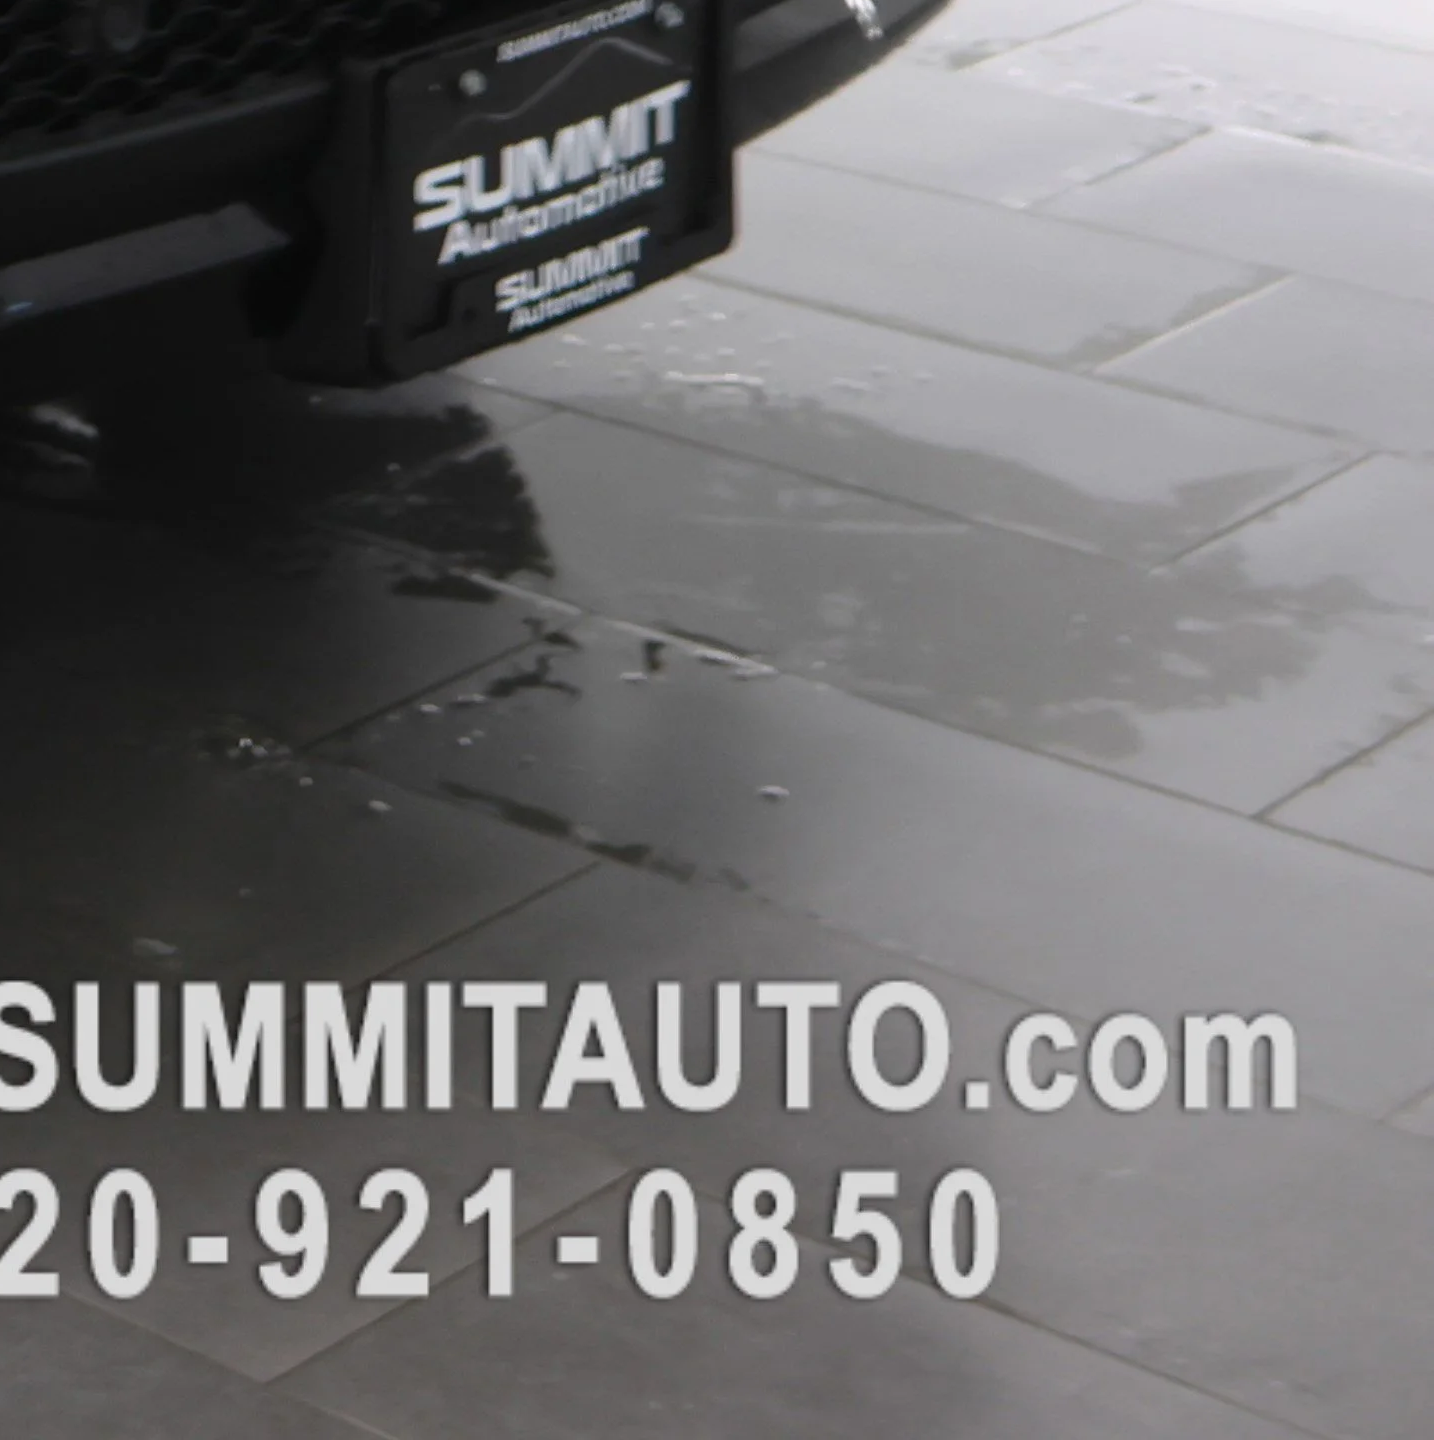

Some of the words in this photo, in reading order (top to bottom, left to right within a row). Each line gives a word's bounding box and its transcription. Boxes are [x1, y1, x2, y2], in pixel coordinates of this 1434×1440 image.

[413, 80, 692, 232] SUMMIT
[437, 156, 665, 265] Automotive
[495, 226, 651, 314] SUMMIT
